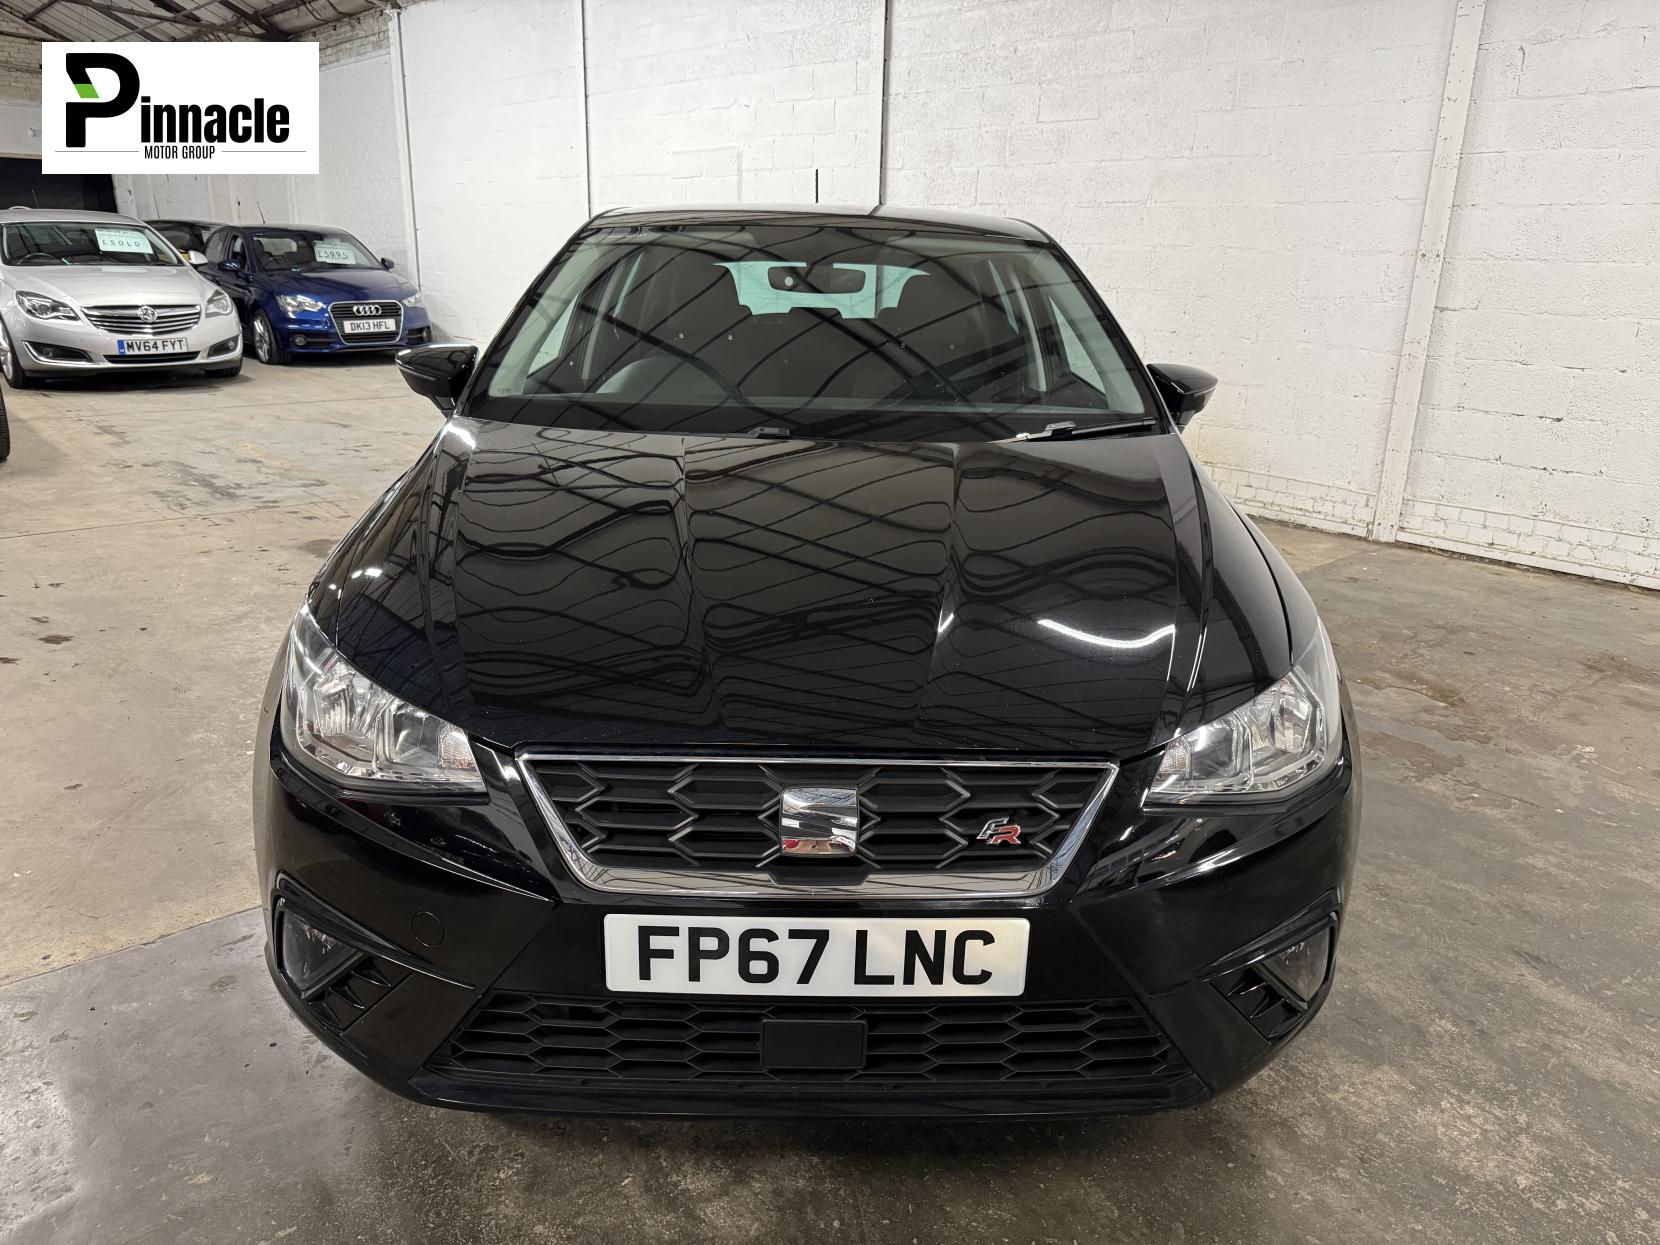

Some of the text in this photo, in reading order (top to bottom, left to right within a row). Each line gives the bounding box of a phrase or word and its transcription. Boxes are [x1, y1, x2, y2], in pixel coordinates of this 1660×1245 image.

[350, 320, 391, 331] DK13 HFL
[126, 340, 184, 353] MV64 FYT
[637, 925, 996, 986] FP67 LNC
